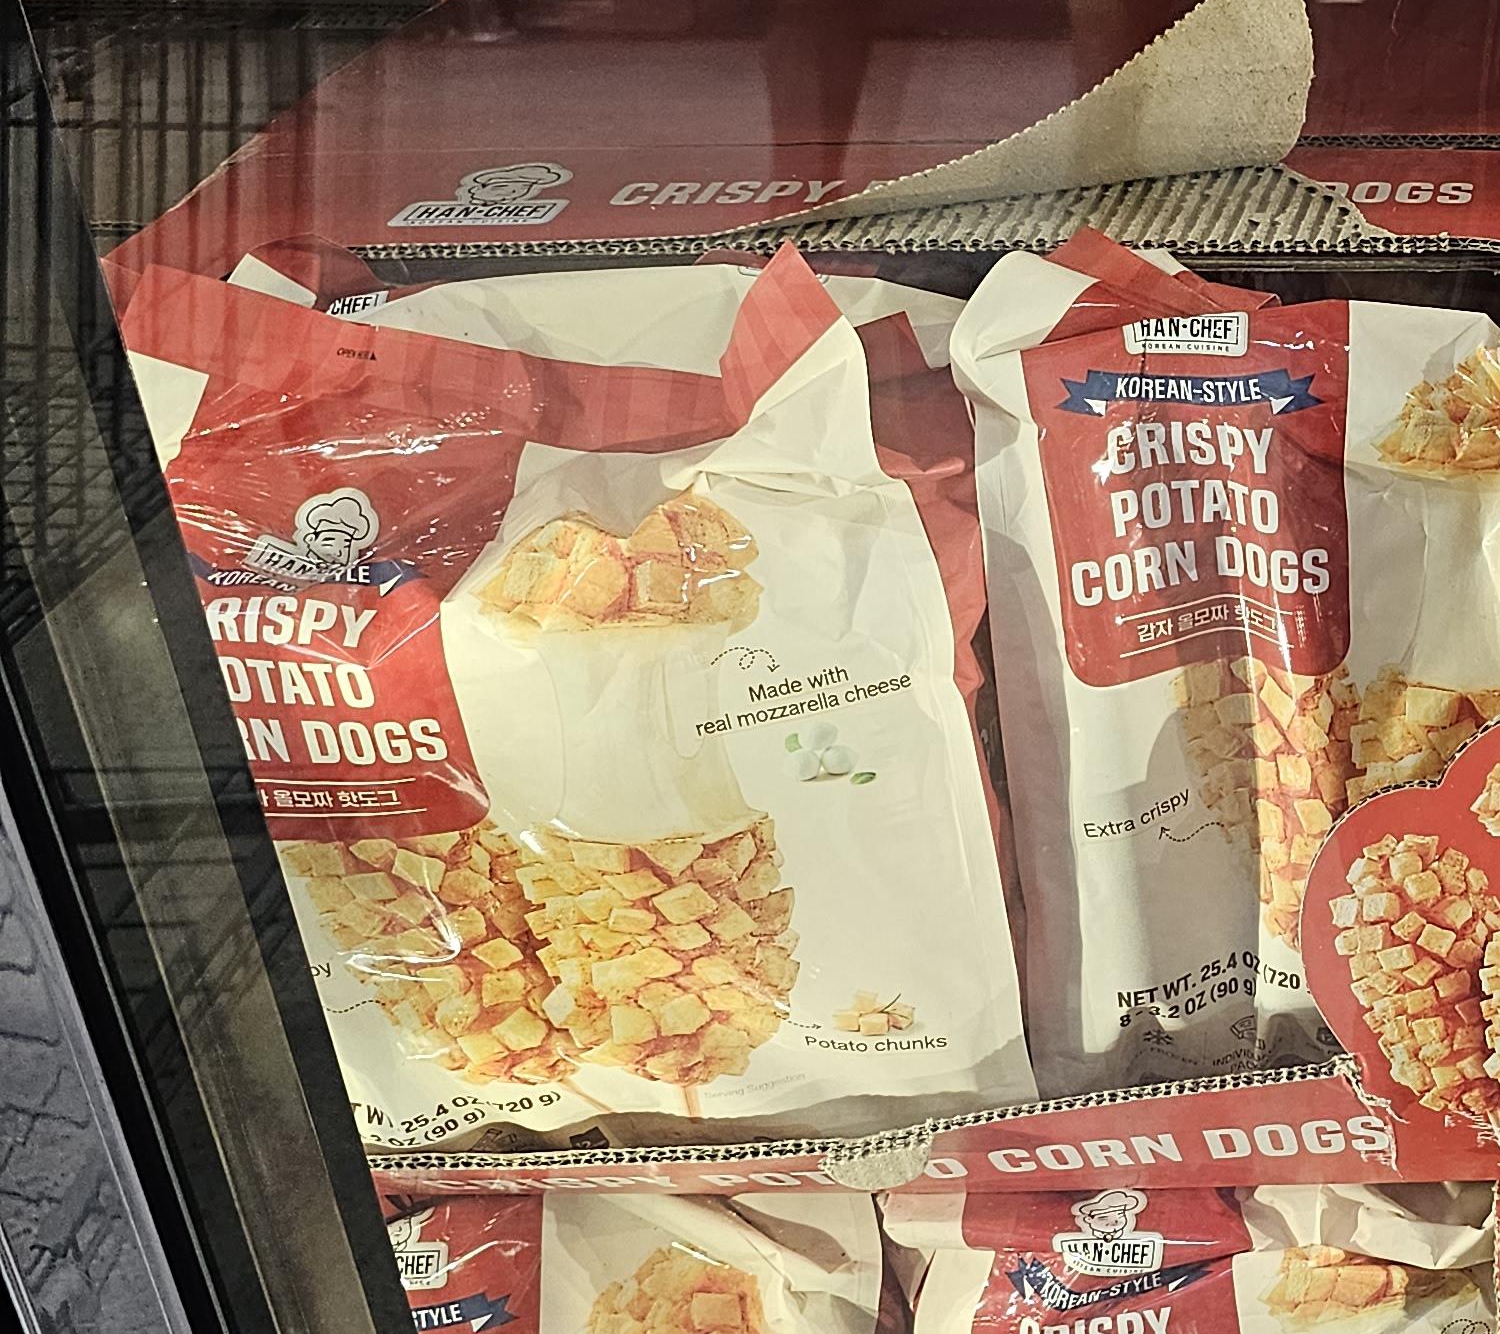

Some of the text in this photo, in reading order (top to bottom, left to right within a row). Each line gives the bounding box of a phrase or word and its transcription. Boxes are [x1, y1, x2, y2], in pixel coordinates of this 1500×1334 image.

[609, 179, 847, 208] CRISPY
[1114, 376, 1263, 403] KOREAN-STYLE
[1105, 419, 1275, 476] CRISPY
[1110, 479, 1279, 539] POTATO
[1070, 535, 1331, 607] CORN DOGS
[1136, 618, 1174, 643] 감자
[695, 672, 912, 738] real mozzarella cheese
[748, 666, 850, 703] Made with
[303, 718, 448, 767] DOGS
[1083, 786, 1191, 840] Extra crispy
[1116, 985, 1158, 1009] NET
[1161, 972, 1198, 1002] WT.
[1199, 950, 1238, 985] 25.4
[804, 1033, 948, 1054] Potato chunks
[986, 1115, 1394, 1174] CORN DOGS
[1039, 1271, 1162, 1310] KOREAN-STYLE
